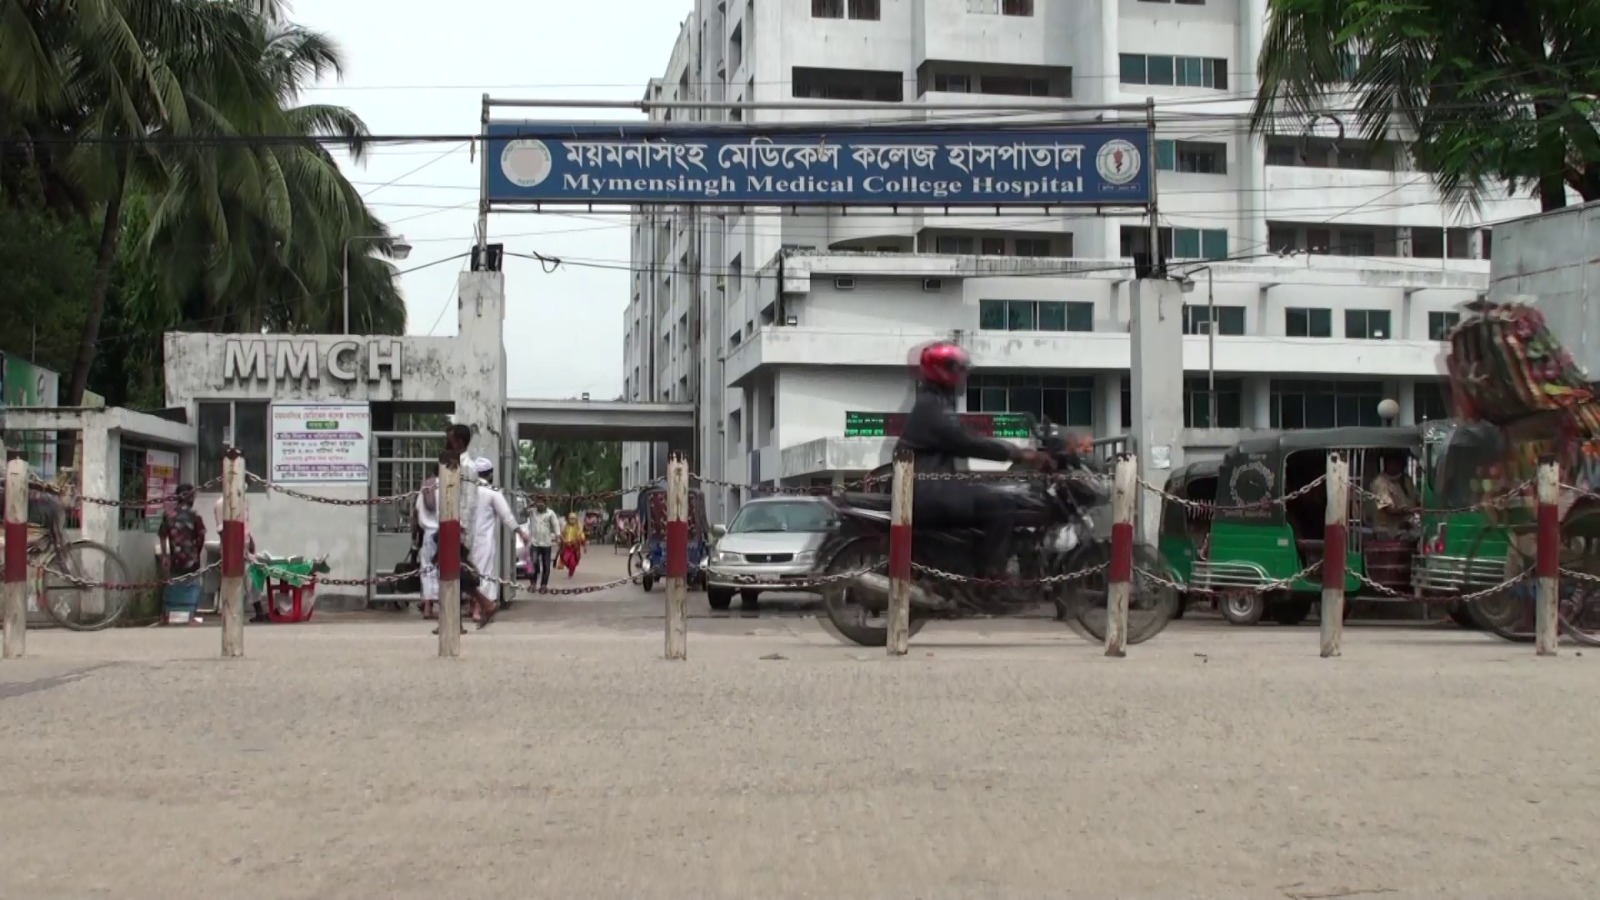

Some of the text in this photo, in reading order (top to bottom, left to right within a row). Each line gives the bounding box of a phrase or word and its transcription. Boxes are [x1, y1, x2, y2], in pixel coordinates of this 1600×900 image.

[718, 137, 842, 171] মেডিকেল
[849, 144, 939, 171] কলেজ
[945, 141, 1086, 174] হাসপাতাল
[563, 174, 1084, 198] Mymensingh Medical College Hospital
[223, 339, 402, 383] MMCH
